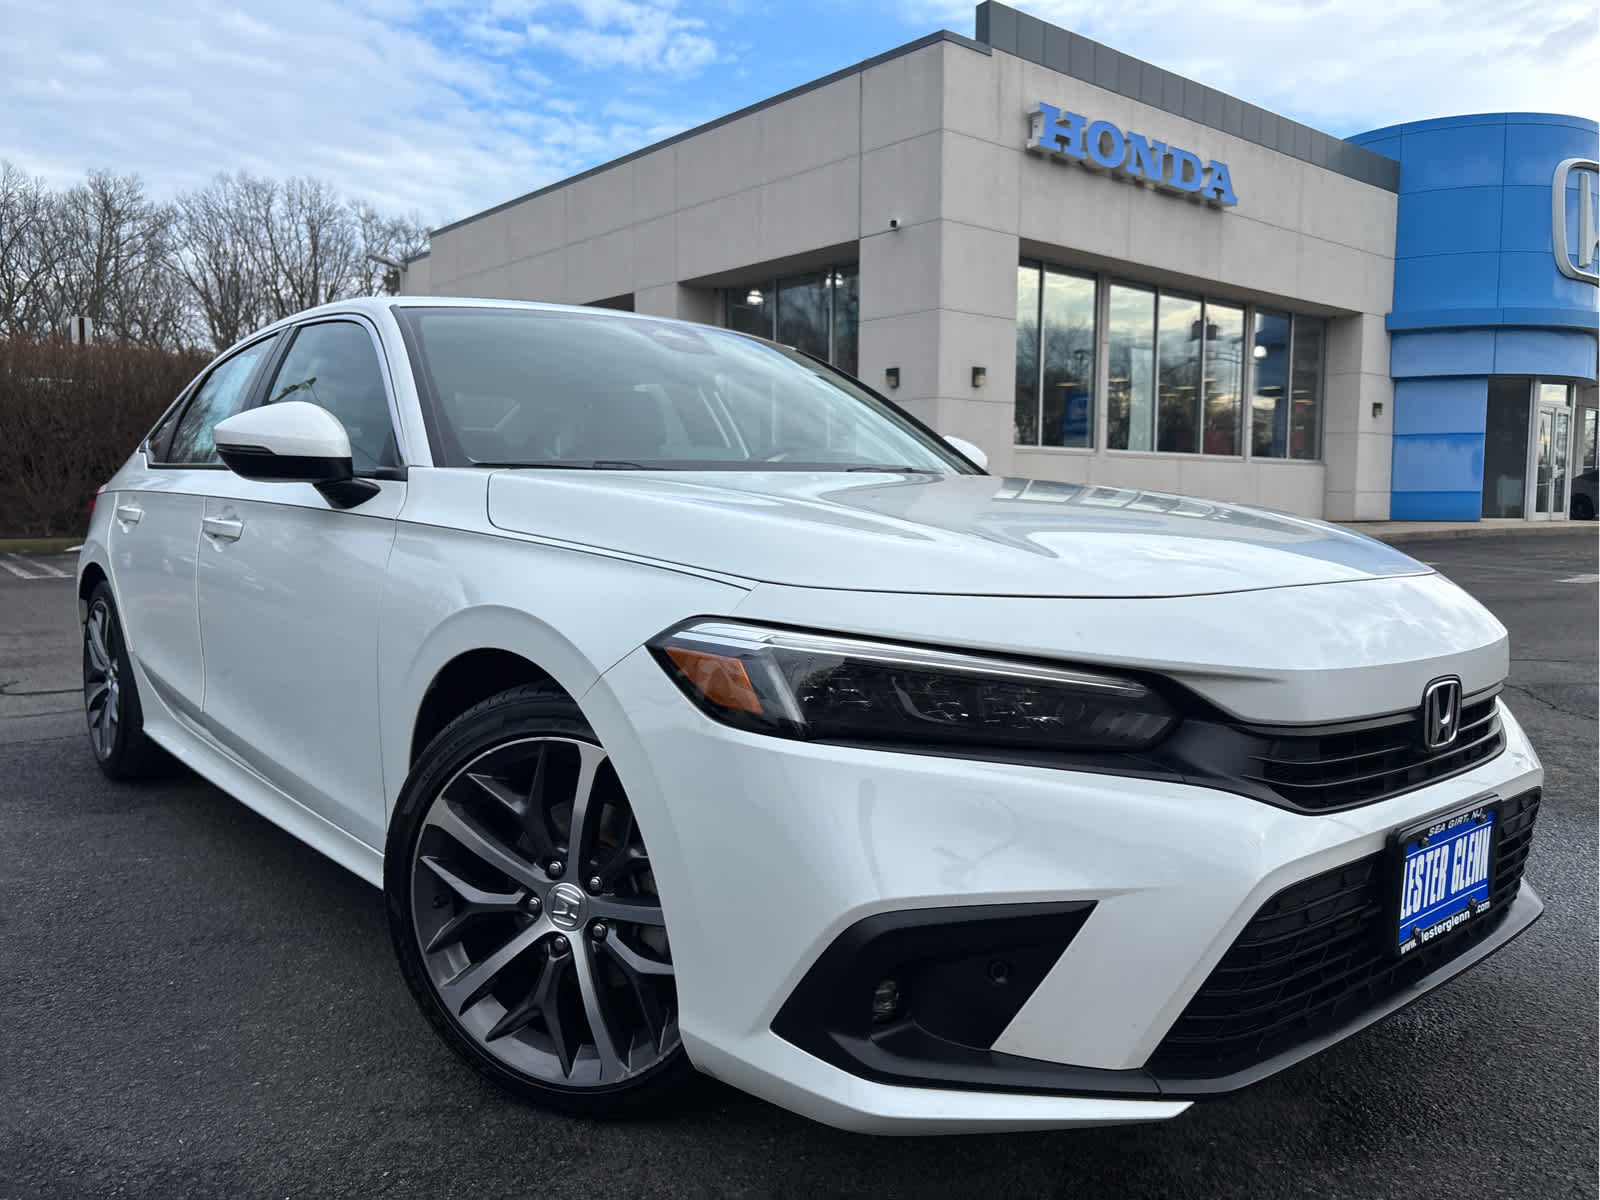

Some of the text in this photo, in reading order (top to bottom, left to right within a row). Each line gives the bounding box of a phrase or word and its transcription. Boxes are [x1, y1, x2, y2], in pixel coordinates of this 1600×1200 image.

[1028, 102, 1238, 206] HONDA
[1428, 823, 1446, 837] SEA
[1400, 825, 1492, 921] LESTER GLENN
[1420, 910, 1471, 943] lesterglenn
